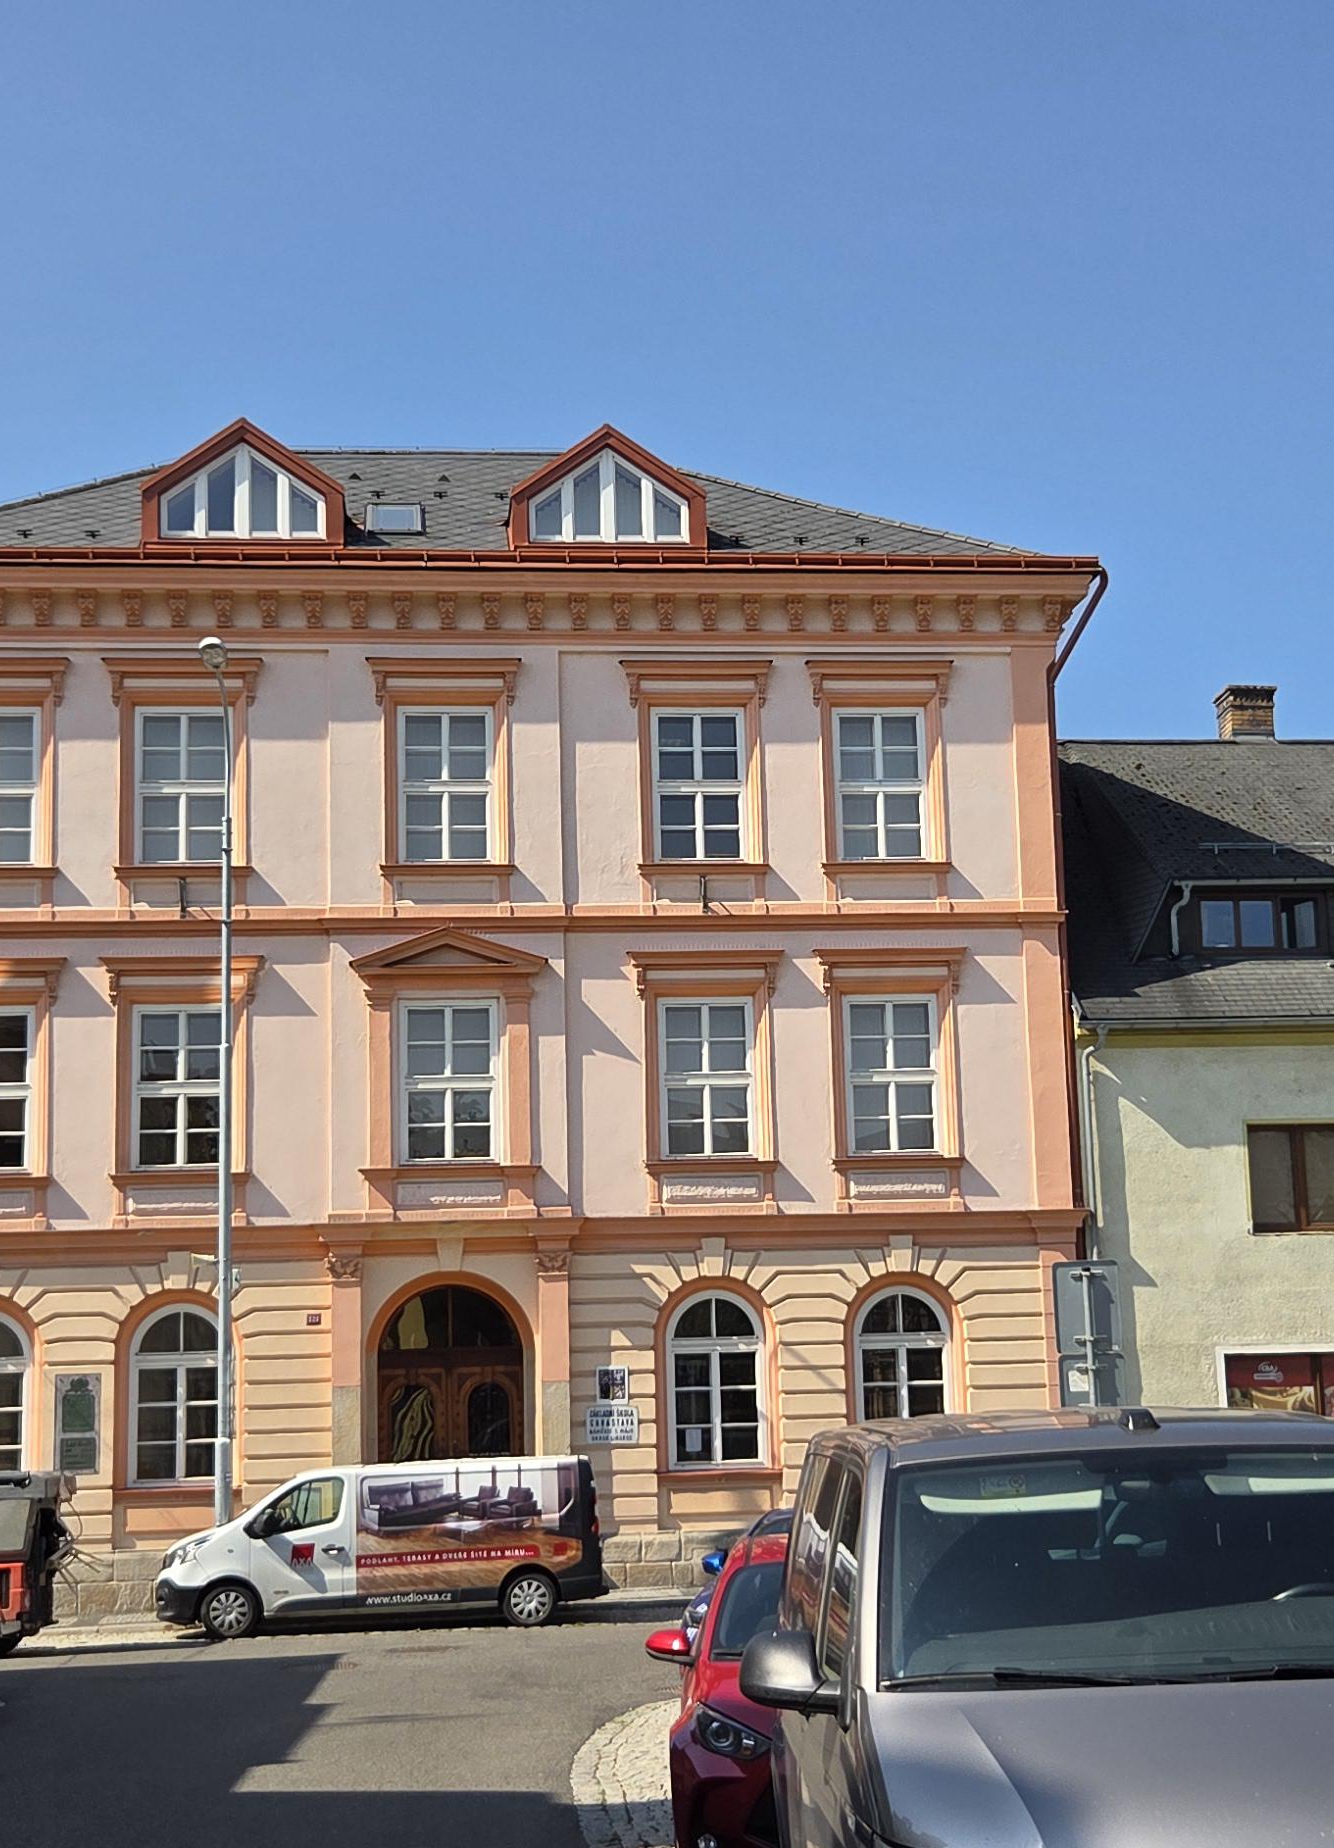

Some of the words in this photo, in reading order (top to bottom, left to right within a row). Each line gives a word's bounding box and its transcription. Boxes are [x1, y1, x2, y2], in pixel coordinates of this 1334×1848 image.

[292, 1557, 313, 1568] AXA
[403, 1554, 431, 1563] TERASY
[365, 1592, 452, 1605] www.studioaxa.cz
